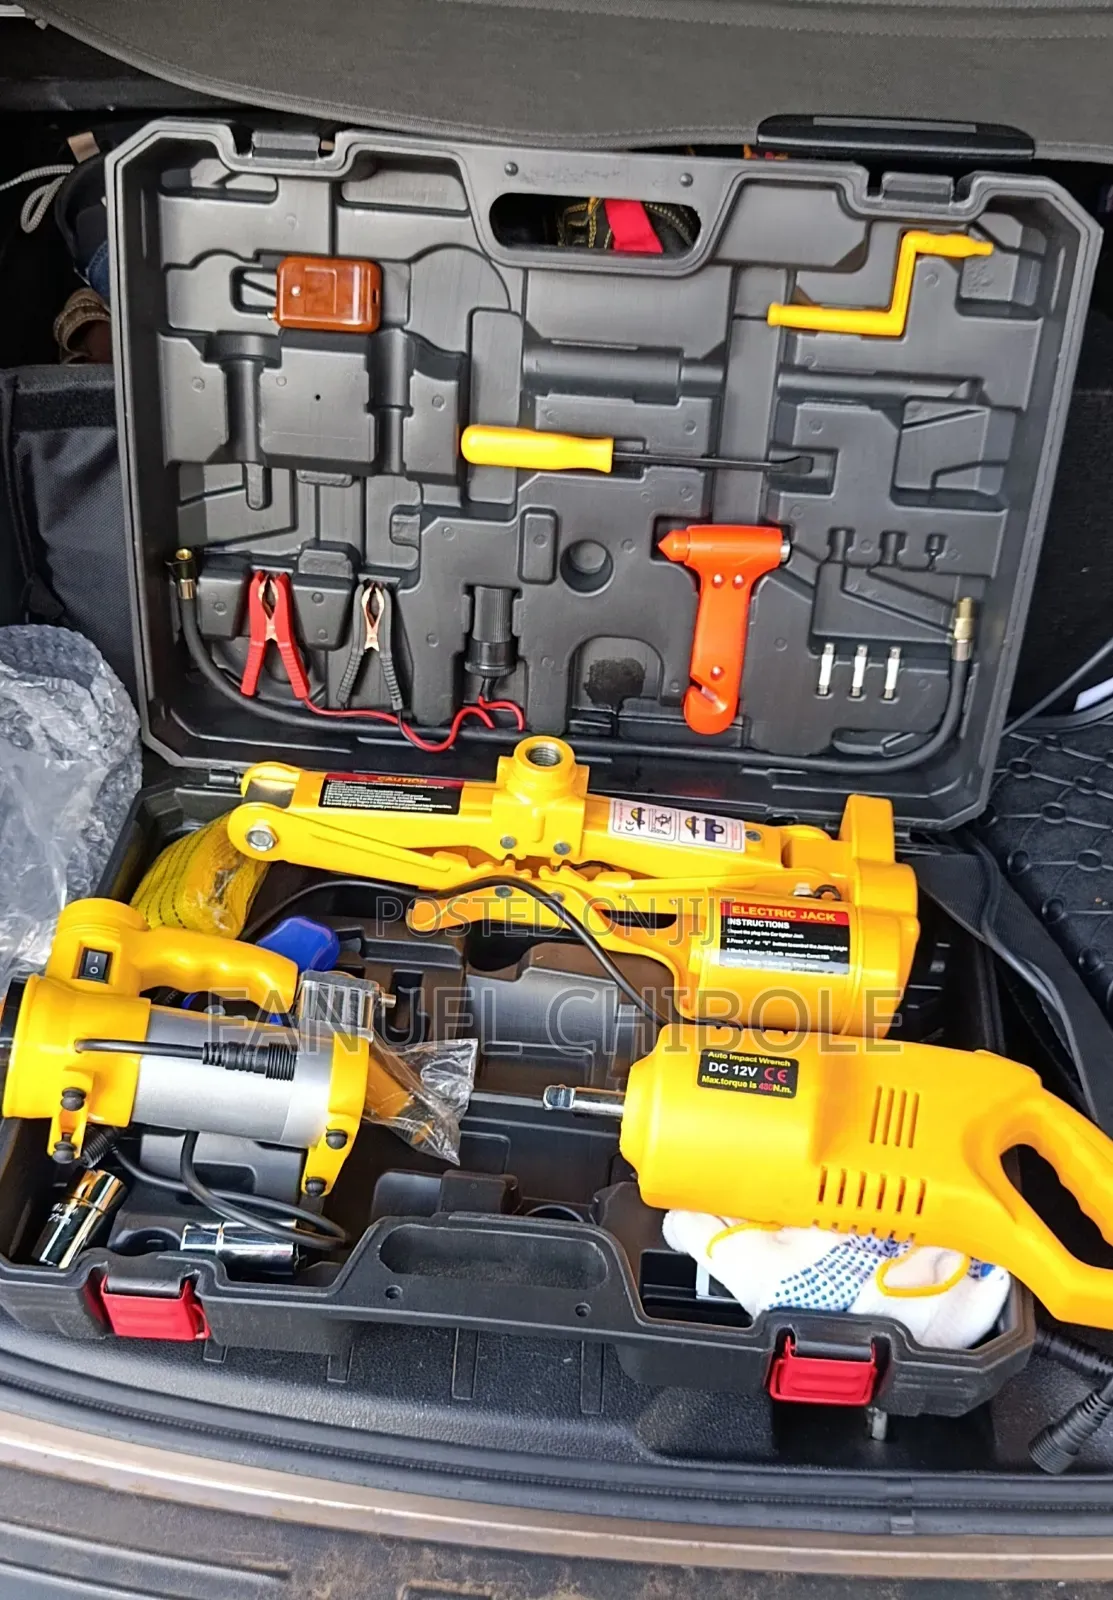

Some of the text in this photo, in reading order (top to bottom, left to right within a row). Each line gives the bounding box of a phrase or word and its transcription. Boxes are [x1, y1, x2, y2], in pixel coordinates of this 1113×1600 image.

[377, 776, 428, 784] CAUTION
[732, 905, 836, 921] ELECTRIC JACK
[727, 917, 790, 929] INSTRUCTIONS
[708, 1051, 791, 1067] Auto Impact Wrench
[708, 1062, 729, 1074] DC
[732, 1065, 758, 1077] 12V
[702, 1075, 748, 1088] Max.torque
[749, 1080, 757, 1089] is
